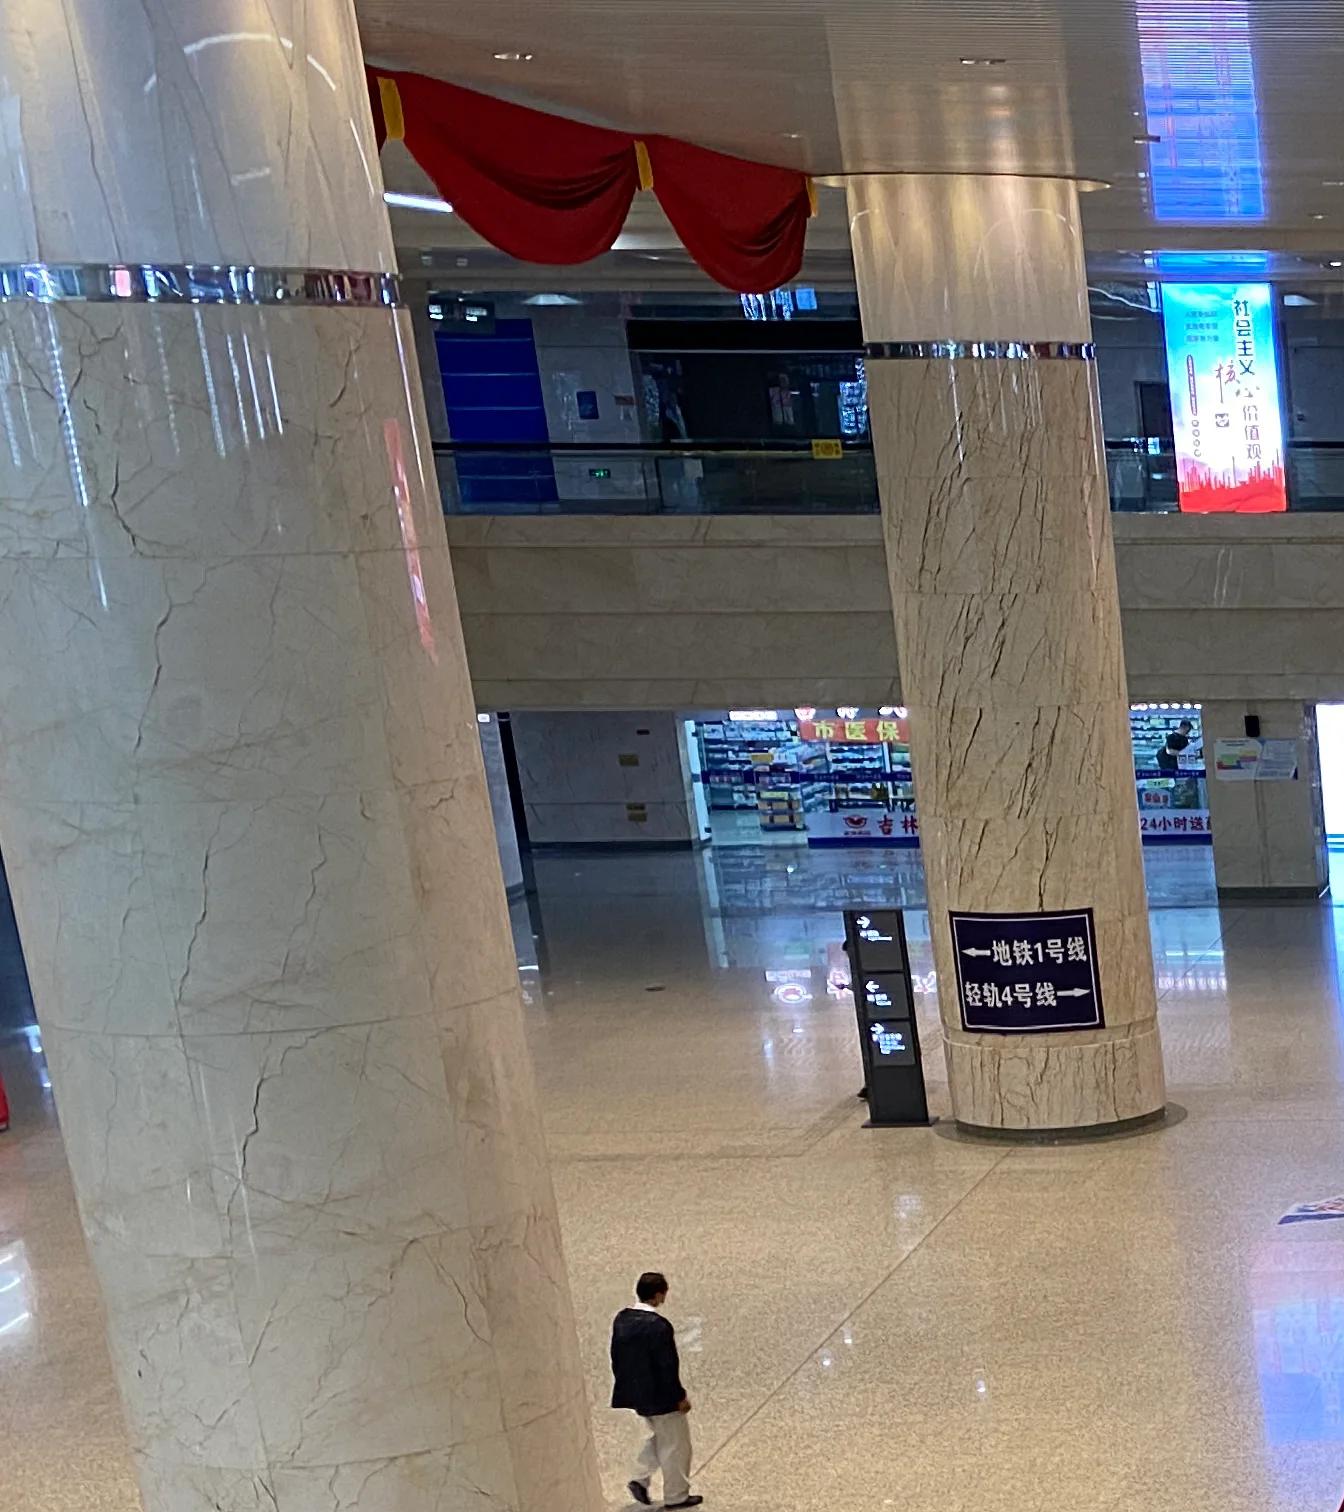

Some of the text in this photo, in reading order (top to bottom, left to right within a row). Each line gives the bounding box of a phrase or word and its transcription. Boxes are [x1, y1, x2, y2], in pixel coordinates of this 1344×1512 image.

[814, 721, 900, 741] 市医保
[877, 814, 918, 836] 吉林
[992, 937, 1087, 966] 地铁1号线
[965, 982, 1057, 1008] 轻轨4号线
